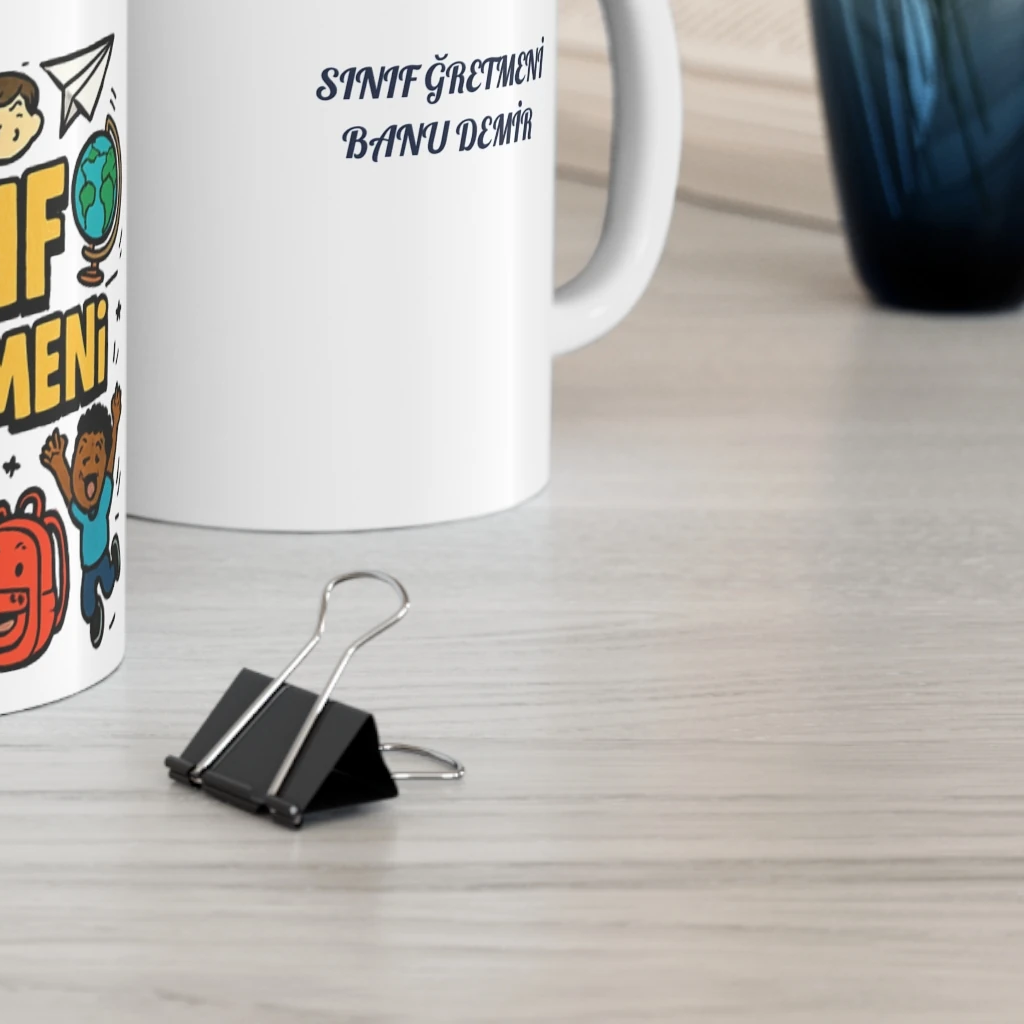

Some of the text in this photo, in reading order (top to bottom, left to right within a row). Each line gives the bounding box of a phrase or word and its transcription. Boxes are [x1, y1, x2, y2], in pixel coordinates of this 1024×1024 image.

[315, 35, 545, 105] SINIF ĞRETMENİ
[341, 99, 533, 163] BANU DEMİR
